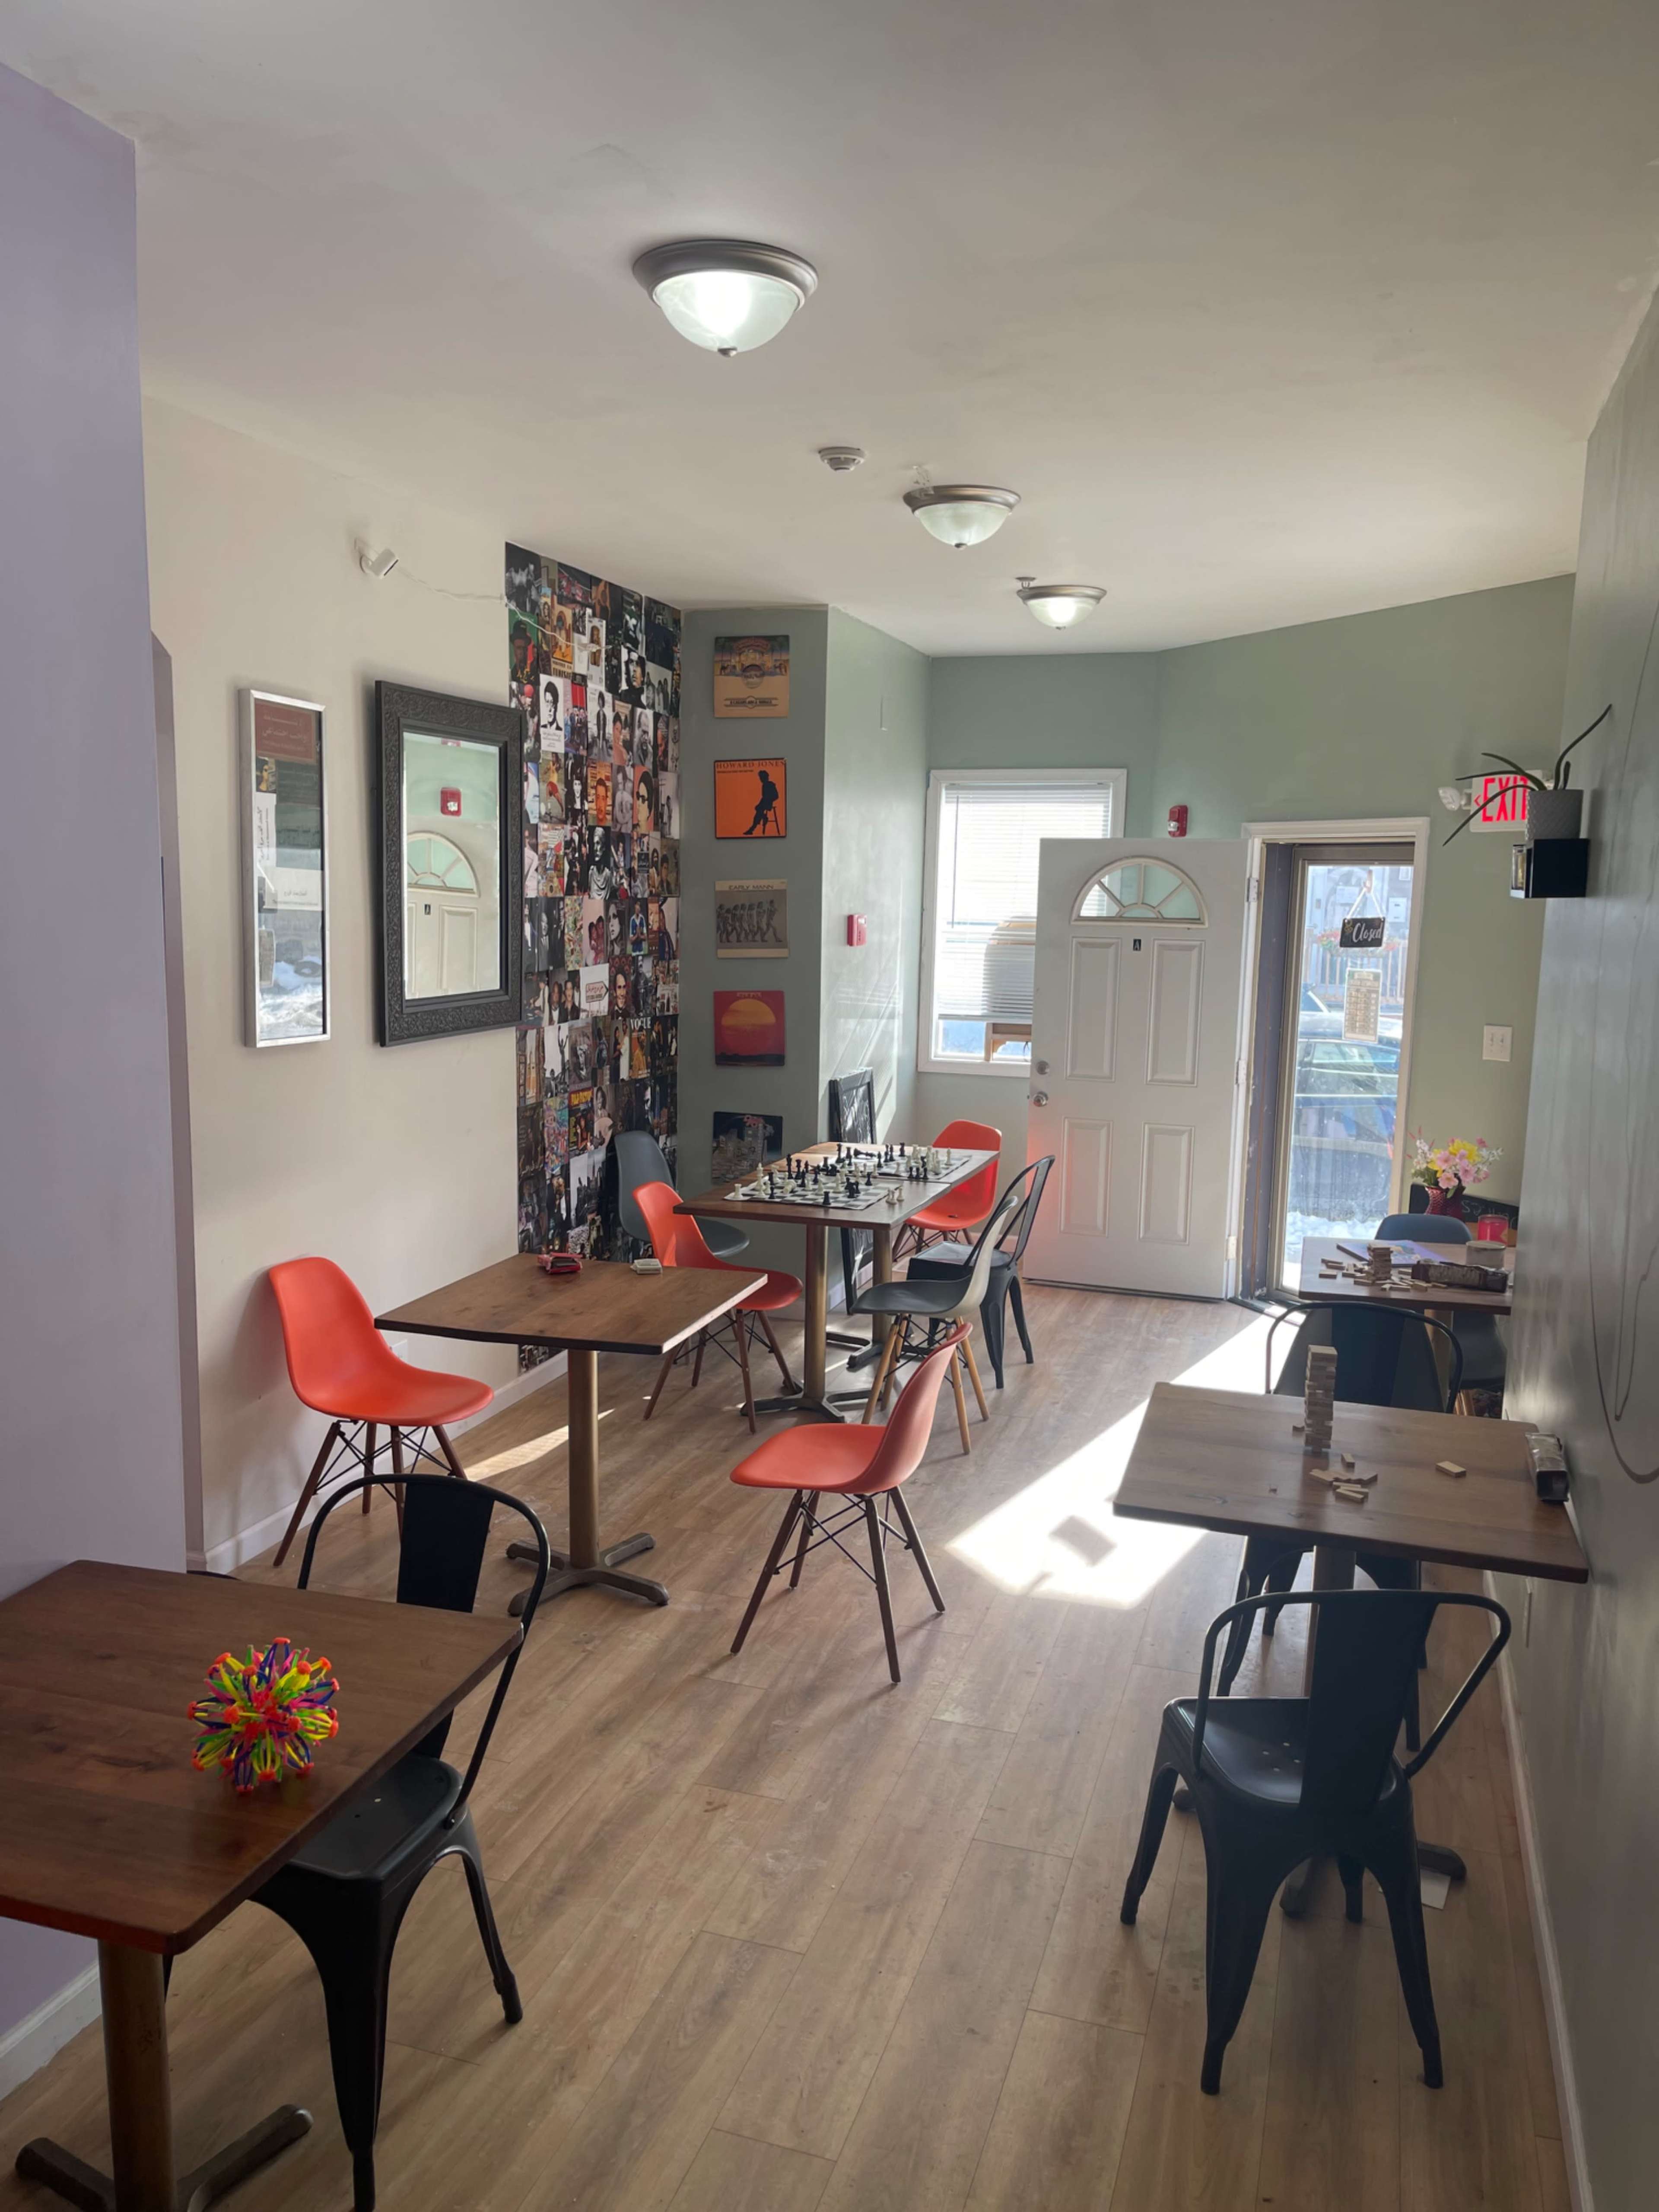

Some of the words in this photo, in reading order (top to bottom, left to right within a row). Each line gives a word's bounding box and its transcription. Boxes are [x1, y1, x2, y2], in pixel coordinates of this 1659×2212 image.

[716, 761, 754, 769] HOWARD
[758, 760, 785, 768] JONES
[1352, 922, 1383, 943] Closed
